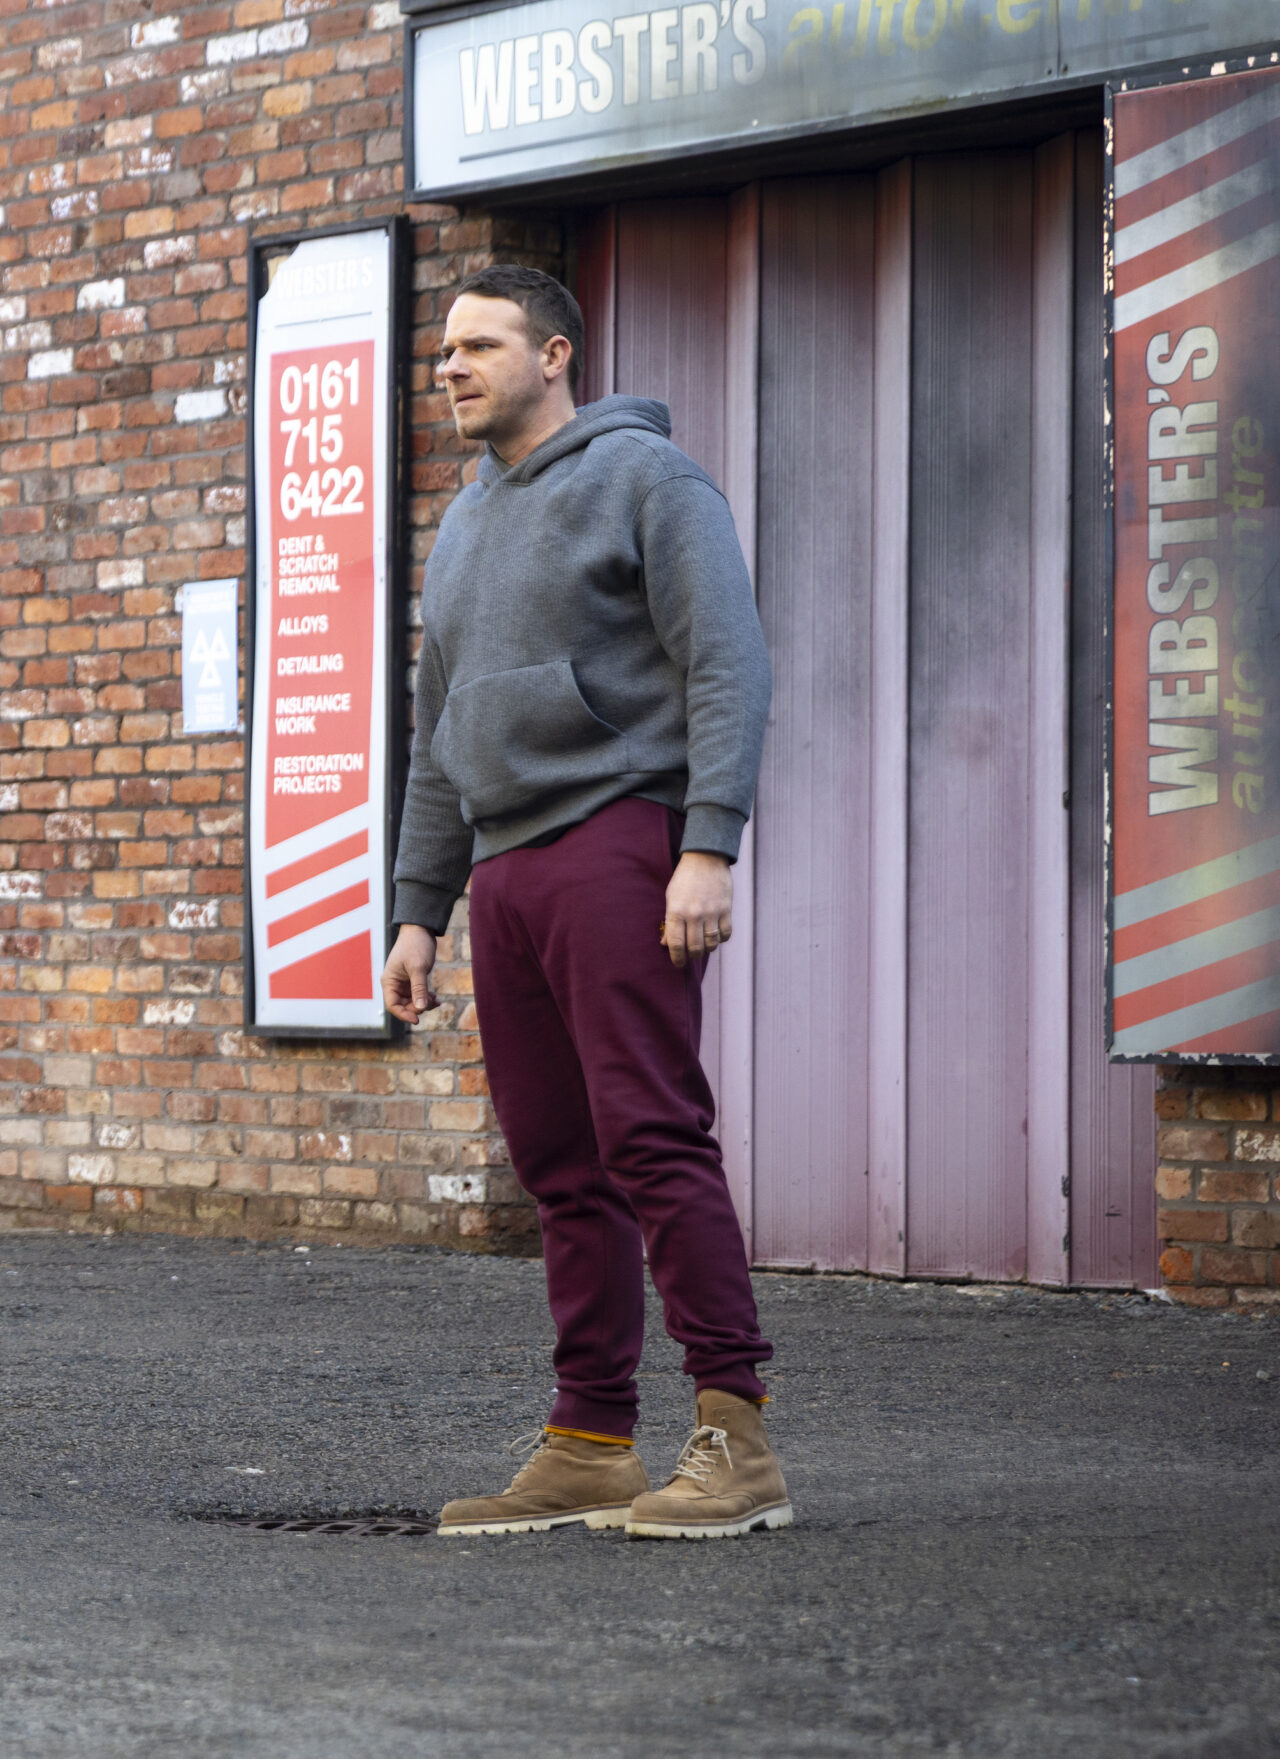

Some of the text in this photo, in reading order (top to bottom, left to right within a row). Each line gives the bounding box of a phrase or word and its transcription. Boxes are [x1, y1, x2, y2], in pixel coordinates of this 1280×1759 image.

[457, 0, 769, 137] WEBSTER'S
[279, 357, 360, 415] 0161
[280, 414, 344, 468] 715
[280, 465, 365, 521] 6422
[278, 534, 325, 556] DENT &
[278, 553, 338, 576] SCRATCH
[1146, 324, 1220, 816] WEBSTER'S
[278, 574, 341, 597] REMOVAL
[277, 614, 329, 637] ALLOYS
[276, 653, 344, 677] DETAILING
[275, 693, 351, 716] INSURANCE
[275, 715, 317, 736] WORK
[273, 752, 364, 776] RESTORATION
[273, 774, 342, 796] PROJECTS
